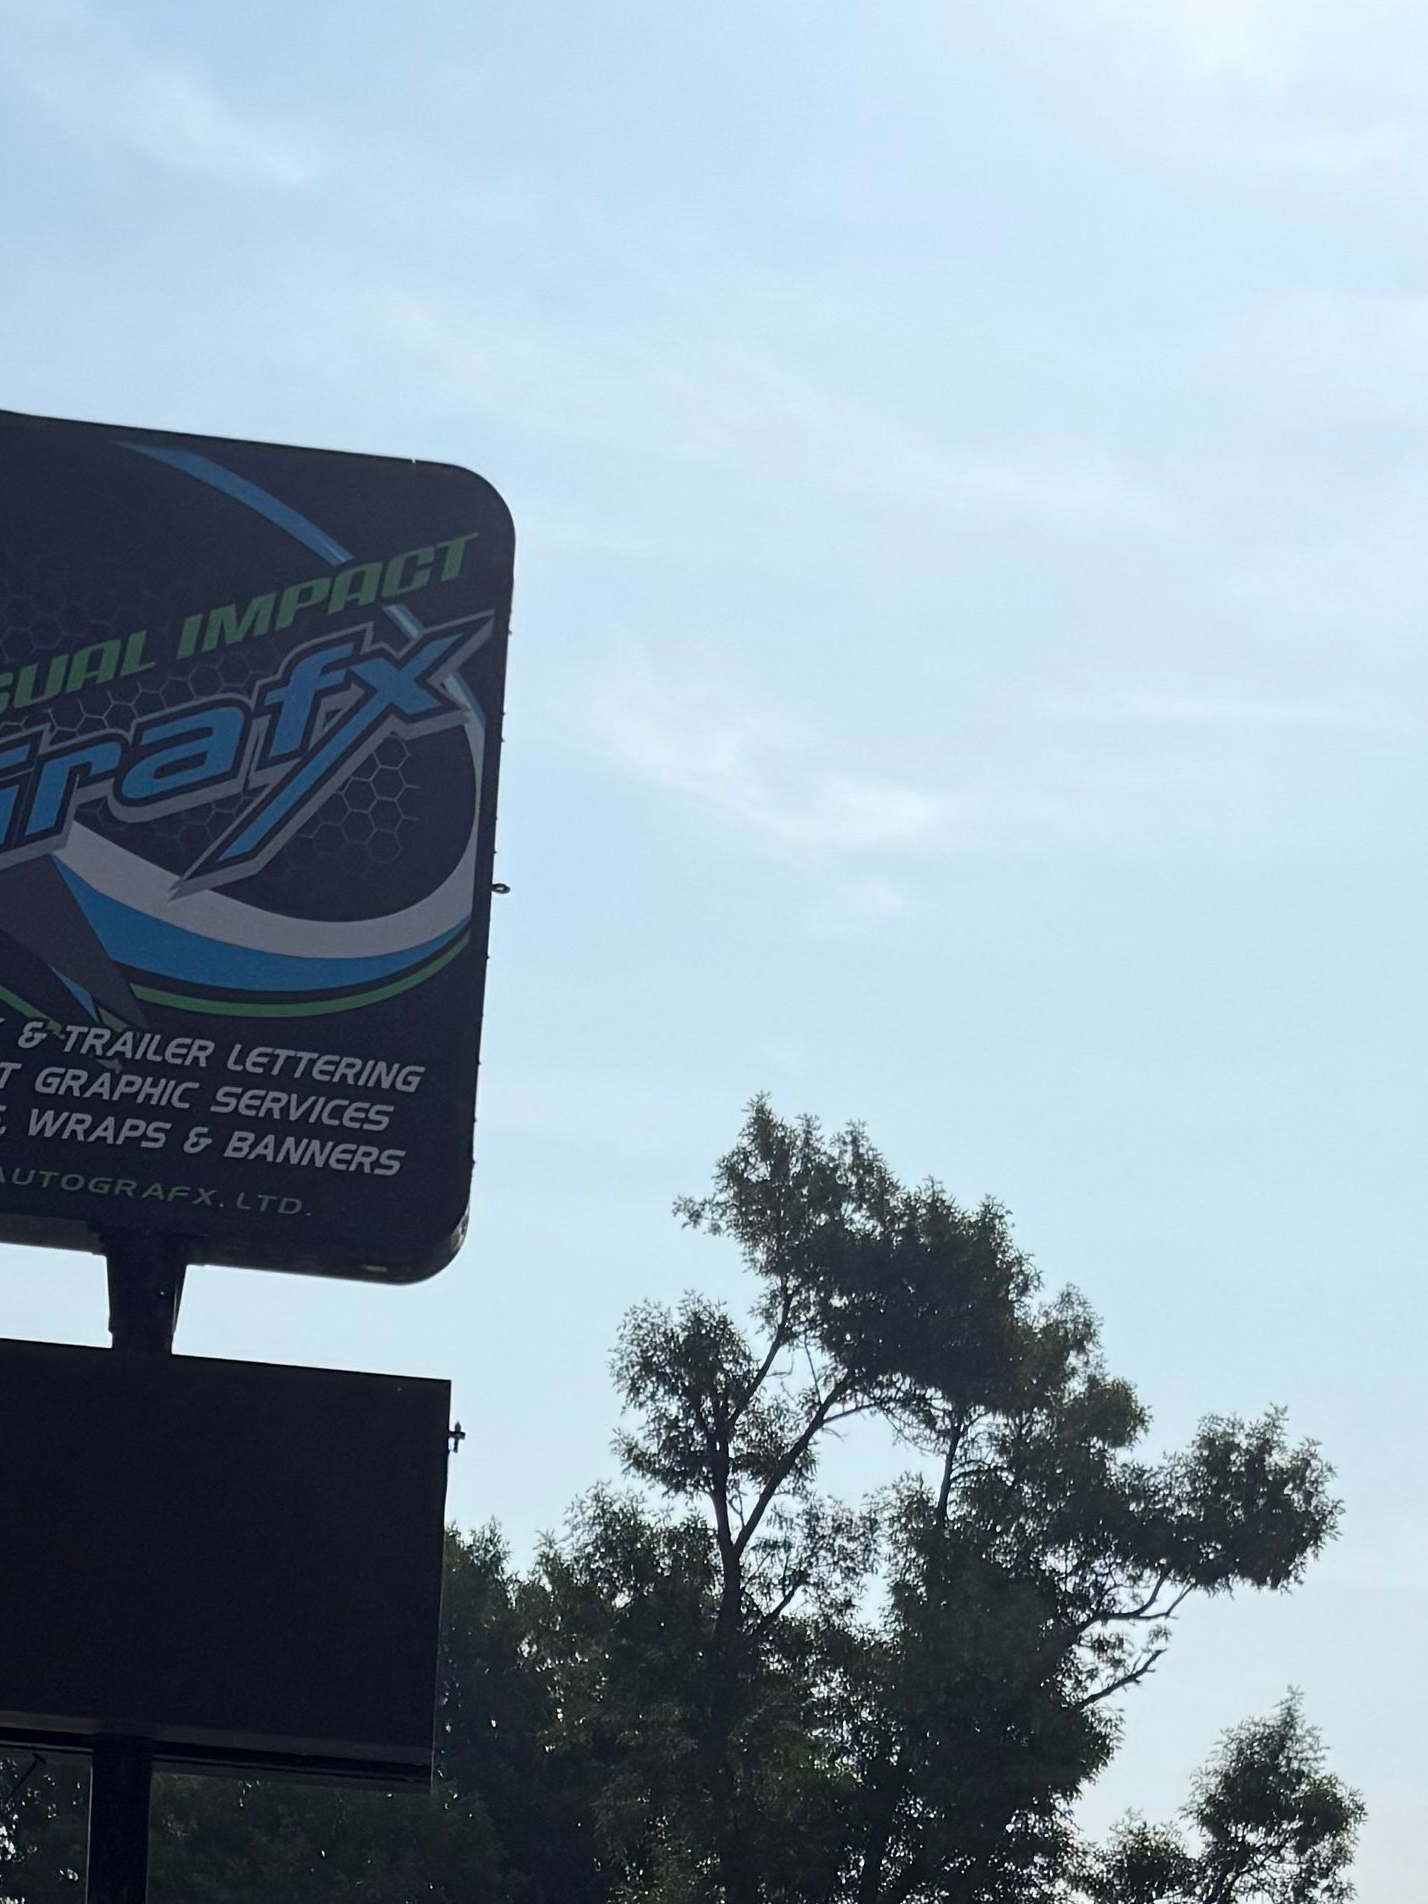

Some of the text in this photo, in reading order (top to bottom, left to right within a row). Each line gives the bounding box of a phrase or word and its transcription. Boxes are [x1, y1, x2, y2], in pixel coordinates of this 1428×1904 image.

[177, 533, 478, 659] IMPACT
[17, 1020, 47, 1048] &
[63, 1024, 215, 1068] TRAILER
[226, 1044, 425, 1093] LETTERING
[34, 1066, 199, 1110] GRAPHIC
[209, 1086, 394, 1131] SERVICES
[27, 1108, 171, 1150] WRAPS
[183, 1126, 212, 1153] &
[224, 1131, 406, 1176] BANNERS
